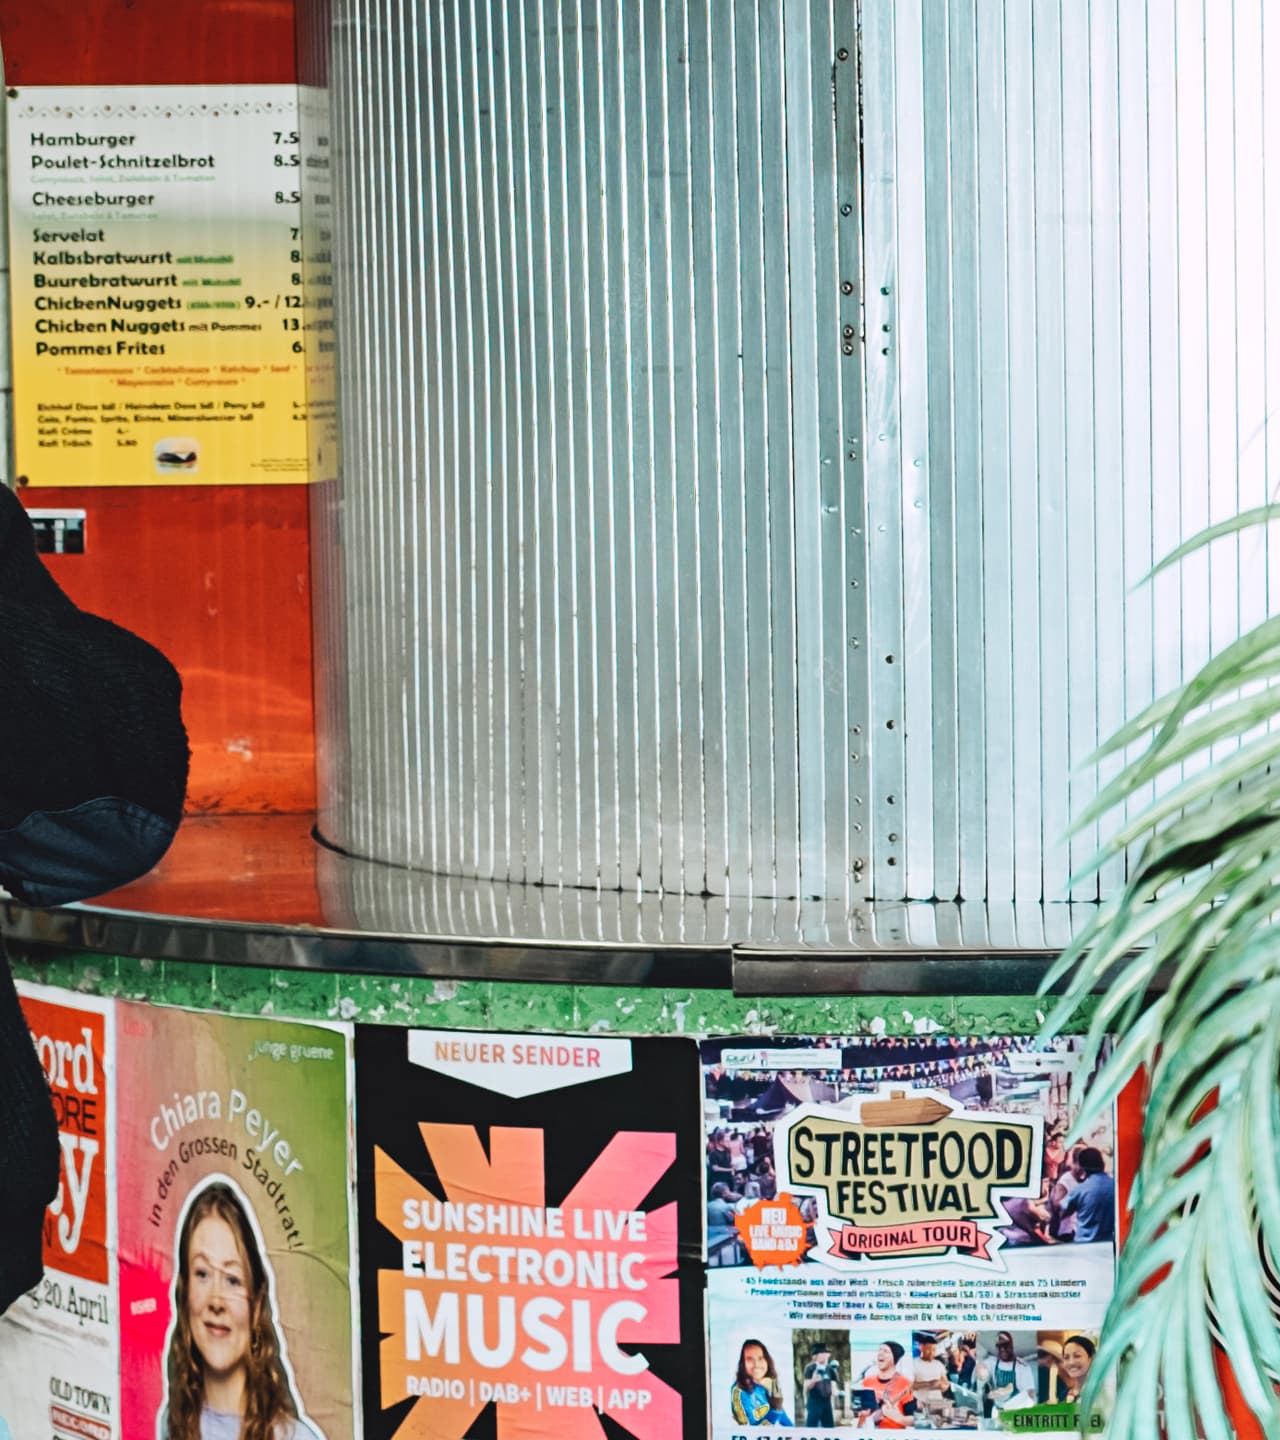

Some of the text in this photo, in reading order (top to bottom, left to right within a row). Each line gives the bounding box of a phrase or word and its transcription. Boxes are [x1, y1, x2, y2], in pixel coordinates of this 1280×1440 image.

[31, 131, 300, 148] Hamburger 7.5
[31, 153, 300, 170] Poulet-Schnitzelbrot 8.5
[32, 191, 301, 208] Cheeseburger 8.5
[33, 228, 104, 243] Servelat
[33, 250, 172, 265] Kalbsbratwurst
[33, 273, 178, 288] Buurebratwurst
[35, 319, 106, 334] Chicken
[111, 318, 184, 335] Nuggets
[36, 342, 111, 356] Pommes
[117, 341, 165, 355] Frites
[435, 1041, 601, 1067] NEUER SENDER
[149, 1088, 304, 1177] Chiara Peyer
[794, 1126, 1024, 1180] STREETFOOD
[146, 1135, 304, 1250] in den Grossen Stadtrat!
[836, 1180, 980, 1216] FESTIVAL
[402, 1199, 647, 1242] SUNSHINE LIVE
[847, 1225, 972, 1250] ORIGINAL TOUR
[402, 1240, 648, 1291] ELECTRONIC
[404, 1289, 650, 1376] MUSIC
[406, 1376, 652, 1411] RADIO DAB+ WEB APP
[1013, 1414, 1103, 1428] EINTRITT FEI
